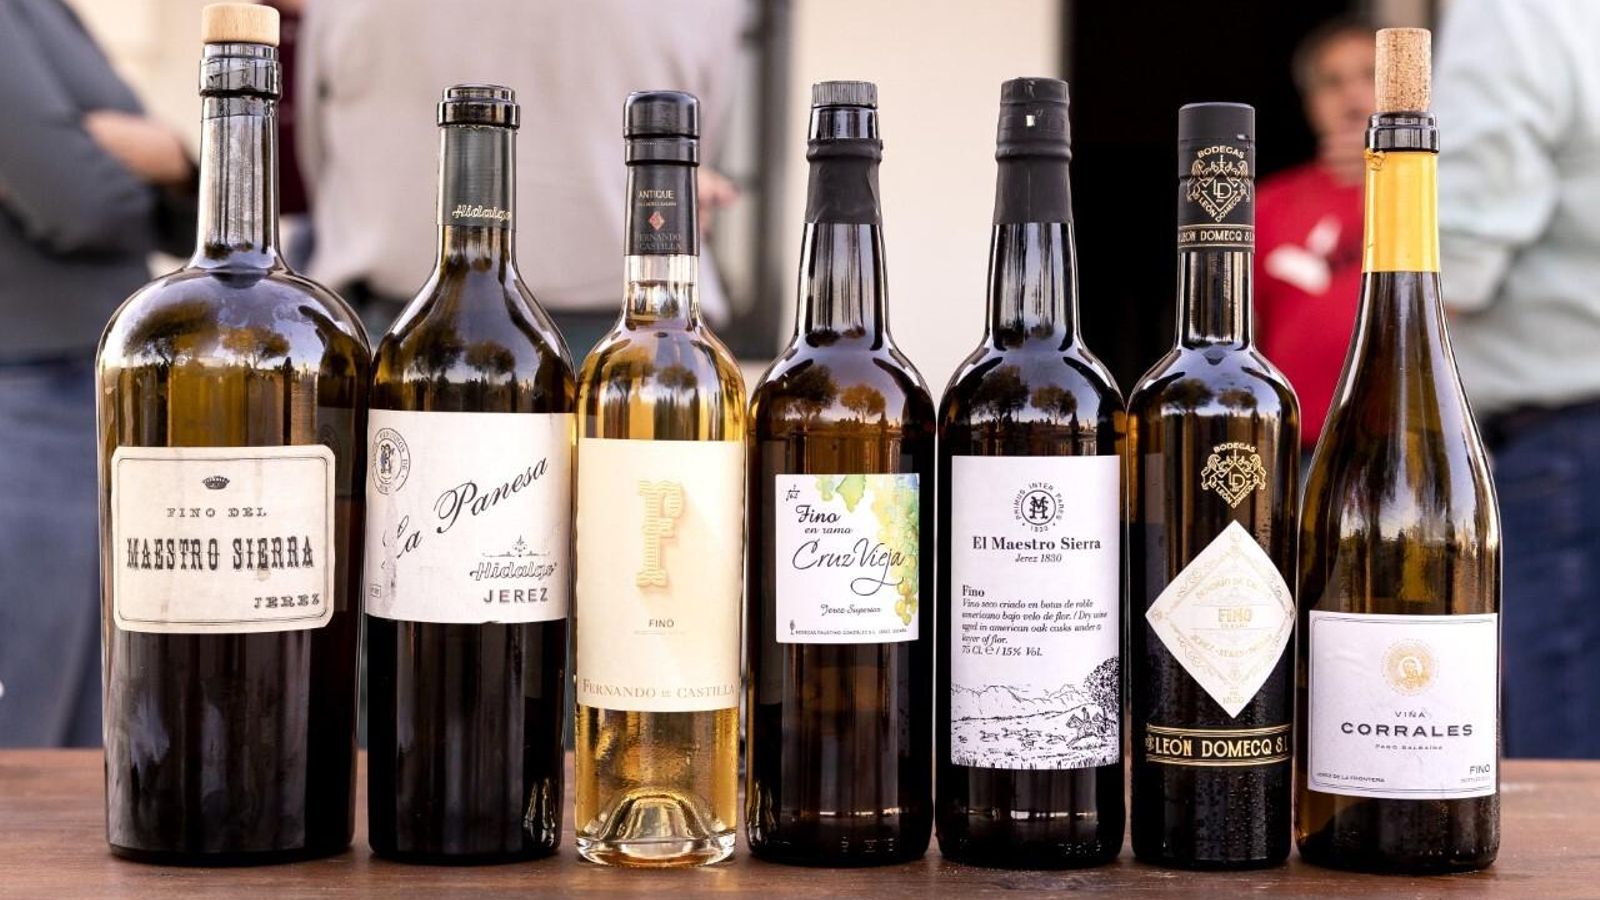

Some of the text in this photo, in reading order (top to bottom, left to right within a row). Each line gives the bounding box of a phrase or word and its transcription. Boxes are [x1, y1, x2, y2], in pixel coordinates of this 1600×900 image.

[1197, 145, 1245, 159] BODEGAS
[639, 190, 675, 199] ANTIQUE
[1214, 195, 1241, 222] DOMECQ
[1200, 230, 1242, 241] DOMECQ
[1213, 442, 1257, 453] BODEGAS
[433, 457, 548, 534] Panesa
[167, 507, 267, 518] FINO DEL
[796, 504, 841, 524] Fino
[972, 536, 1101, 550] El Maestro Sierra
[127, 535, 314, 571] MAESTRO SIERRA
[1015, 553, 1062, 563] Jerez 1830
[469, 561, 557, 581] Hidalgo
[792, 537, 905, 596] Cruz Vieja
[484, 587, 549, 604] JEREZ
[962, 584, 985, 597] Fino
[254, 593, 320, 609] JEREZ
[962, 598, 980, 608] Vino
[999, 600, 1026, 609] criado
[1040, 599, 1062, 609] botas
[1064, 599, 1074, 609] de
[962, 610, 1000, 620] americano
[1002, 610, 1021, 623] bajo
[1023, 611, 1041, 620] velo
[1043, 611, 1054, 620] de
[1053, 611, 1071, 623] flor.
[1078, 610, 1091, 622] Dry
[1218, 608, 1252, 622] FINO
[648, 618, 675, 628] FINO
[979, 622, 987, 631] in
[989, 624, 1029, 632] american
[1031, 622, 1048, 632] oak
[1049, 622, 1072, 632] casks
[981, 634, 991, 646] of
[989, 634, 1008, 646] flor.
[961, 645, 971, 654] 75
[1002, 646, 1022, 656] 15%
[1026, 646, 1043, 657] Vol.
[582, 678, 656, 699] FERNANDO
[676, 681, 736, 699] CASTILLA
[1394, 710, 1426, 718] VIÑA
[1341, 722, 1473, 737] CORRALES
[1155, 735, 1192, 757] LEÓN
[1201, 738, 1272, 758] DOMECQ
[1469, 764, 1491, 775] FINO
